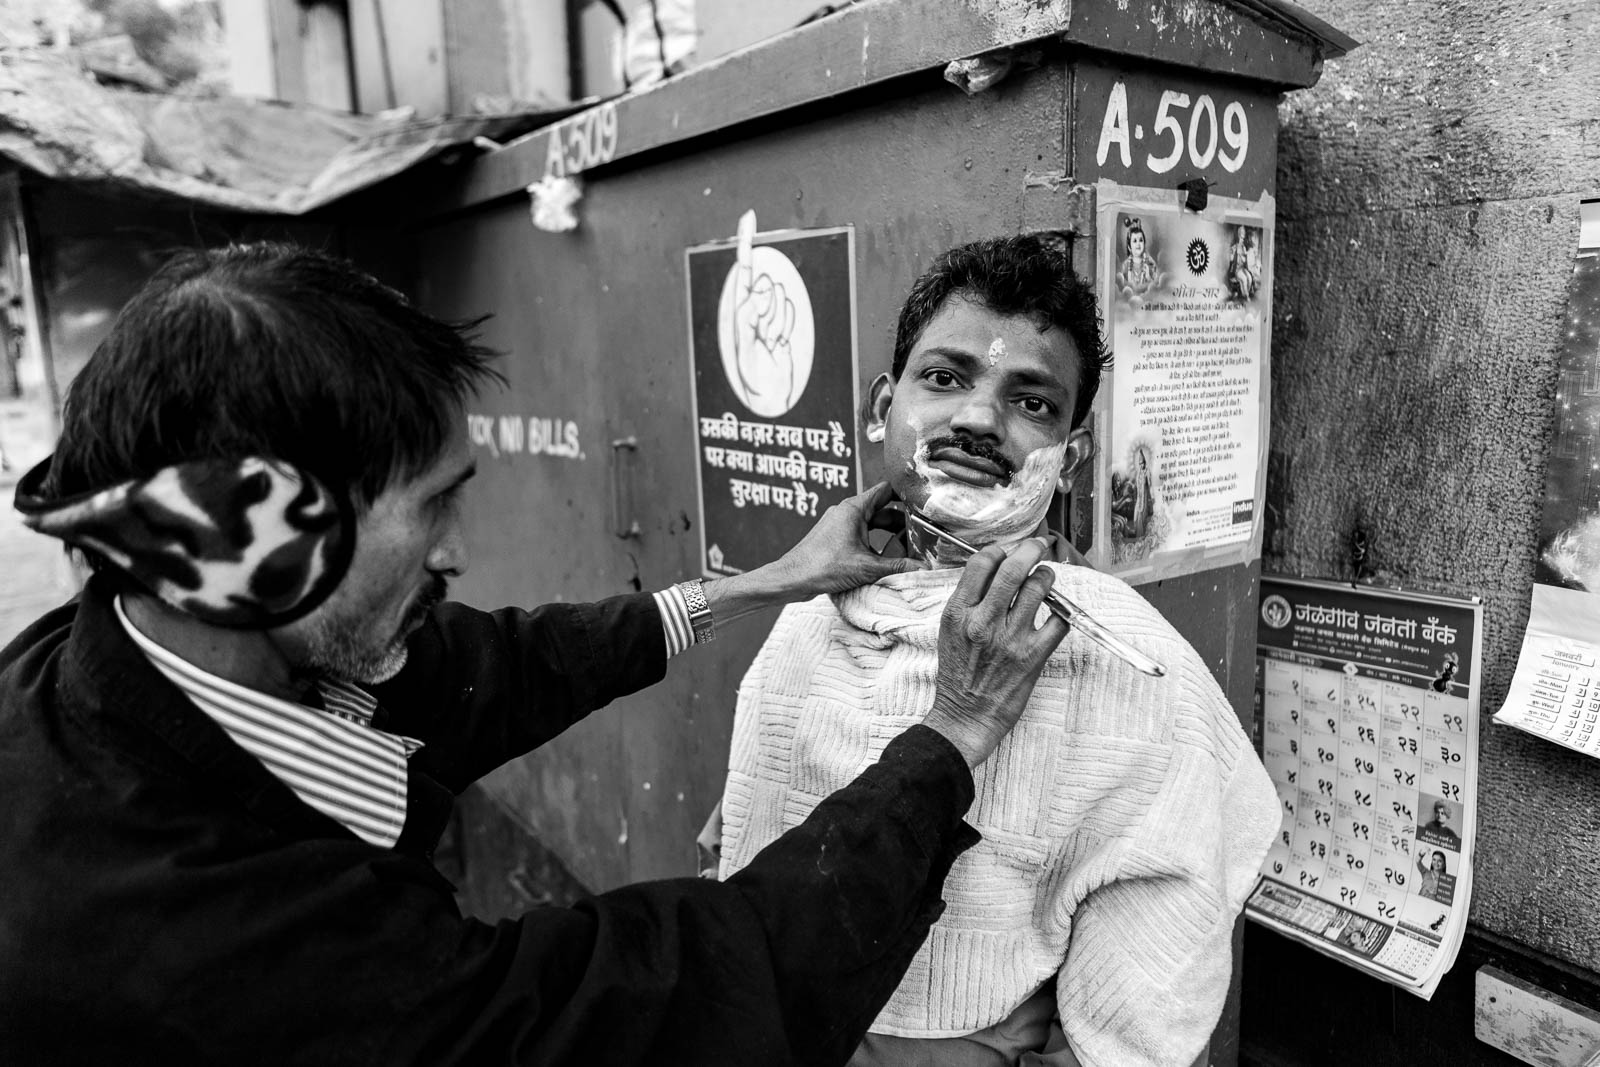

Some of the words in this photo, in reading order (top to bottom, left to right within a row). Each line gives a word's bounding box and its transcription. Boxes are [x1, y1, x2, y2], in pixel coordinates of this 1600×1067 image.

[499, 414, 524, 453] NO
[700, 412, 738, 441] उसकी
[740, 421, 774, 448] नज़र
[774, 424, 803, 449] सब
[805, 428, 829, 451] पर
[704, 446, 725, 468] पर
[726, 448, 753, 473] क्या
[755, 450, 807, 481] आपकी
[809, 460, 849, 490] नज़र
[729, 478, 770, 508] सुरक्षा
[771, 486, 793, 510] पर
[1295, 603, 1360, 630] जळगाव
[1363, 613, 1418, 641] जनता
[1421, 616, 1458, 646] बँक
[1400, 703, 1420, 721] २२
[1443, 713, 1463, 732] २९
[1398, 736, 1418, 755] २३
[1441, 746, 1461, 764] ३०
[1317, 747, 1334, 763] १०
[1354, 757, 1374, 774] १७
[1393, 768, 1416, 786] २४
[1440, 781, 1460, 801] ३१
[1314, 809, 1331, 827] १२
[1354, 789, 1372, 807] १८
[1392, 801, 1413, 821] २५
[1346, 854, 1364, 869] २०
[1384, 868, 1405, 886] २७
[1377, 901, 1396, 919] २८
